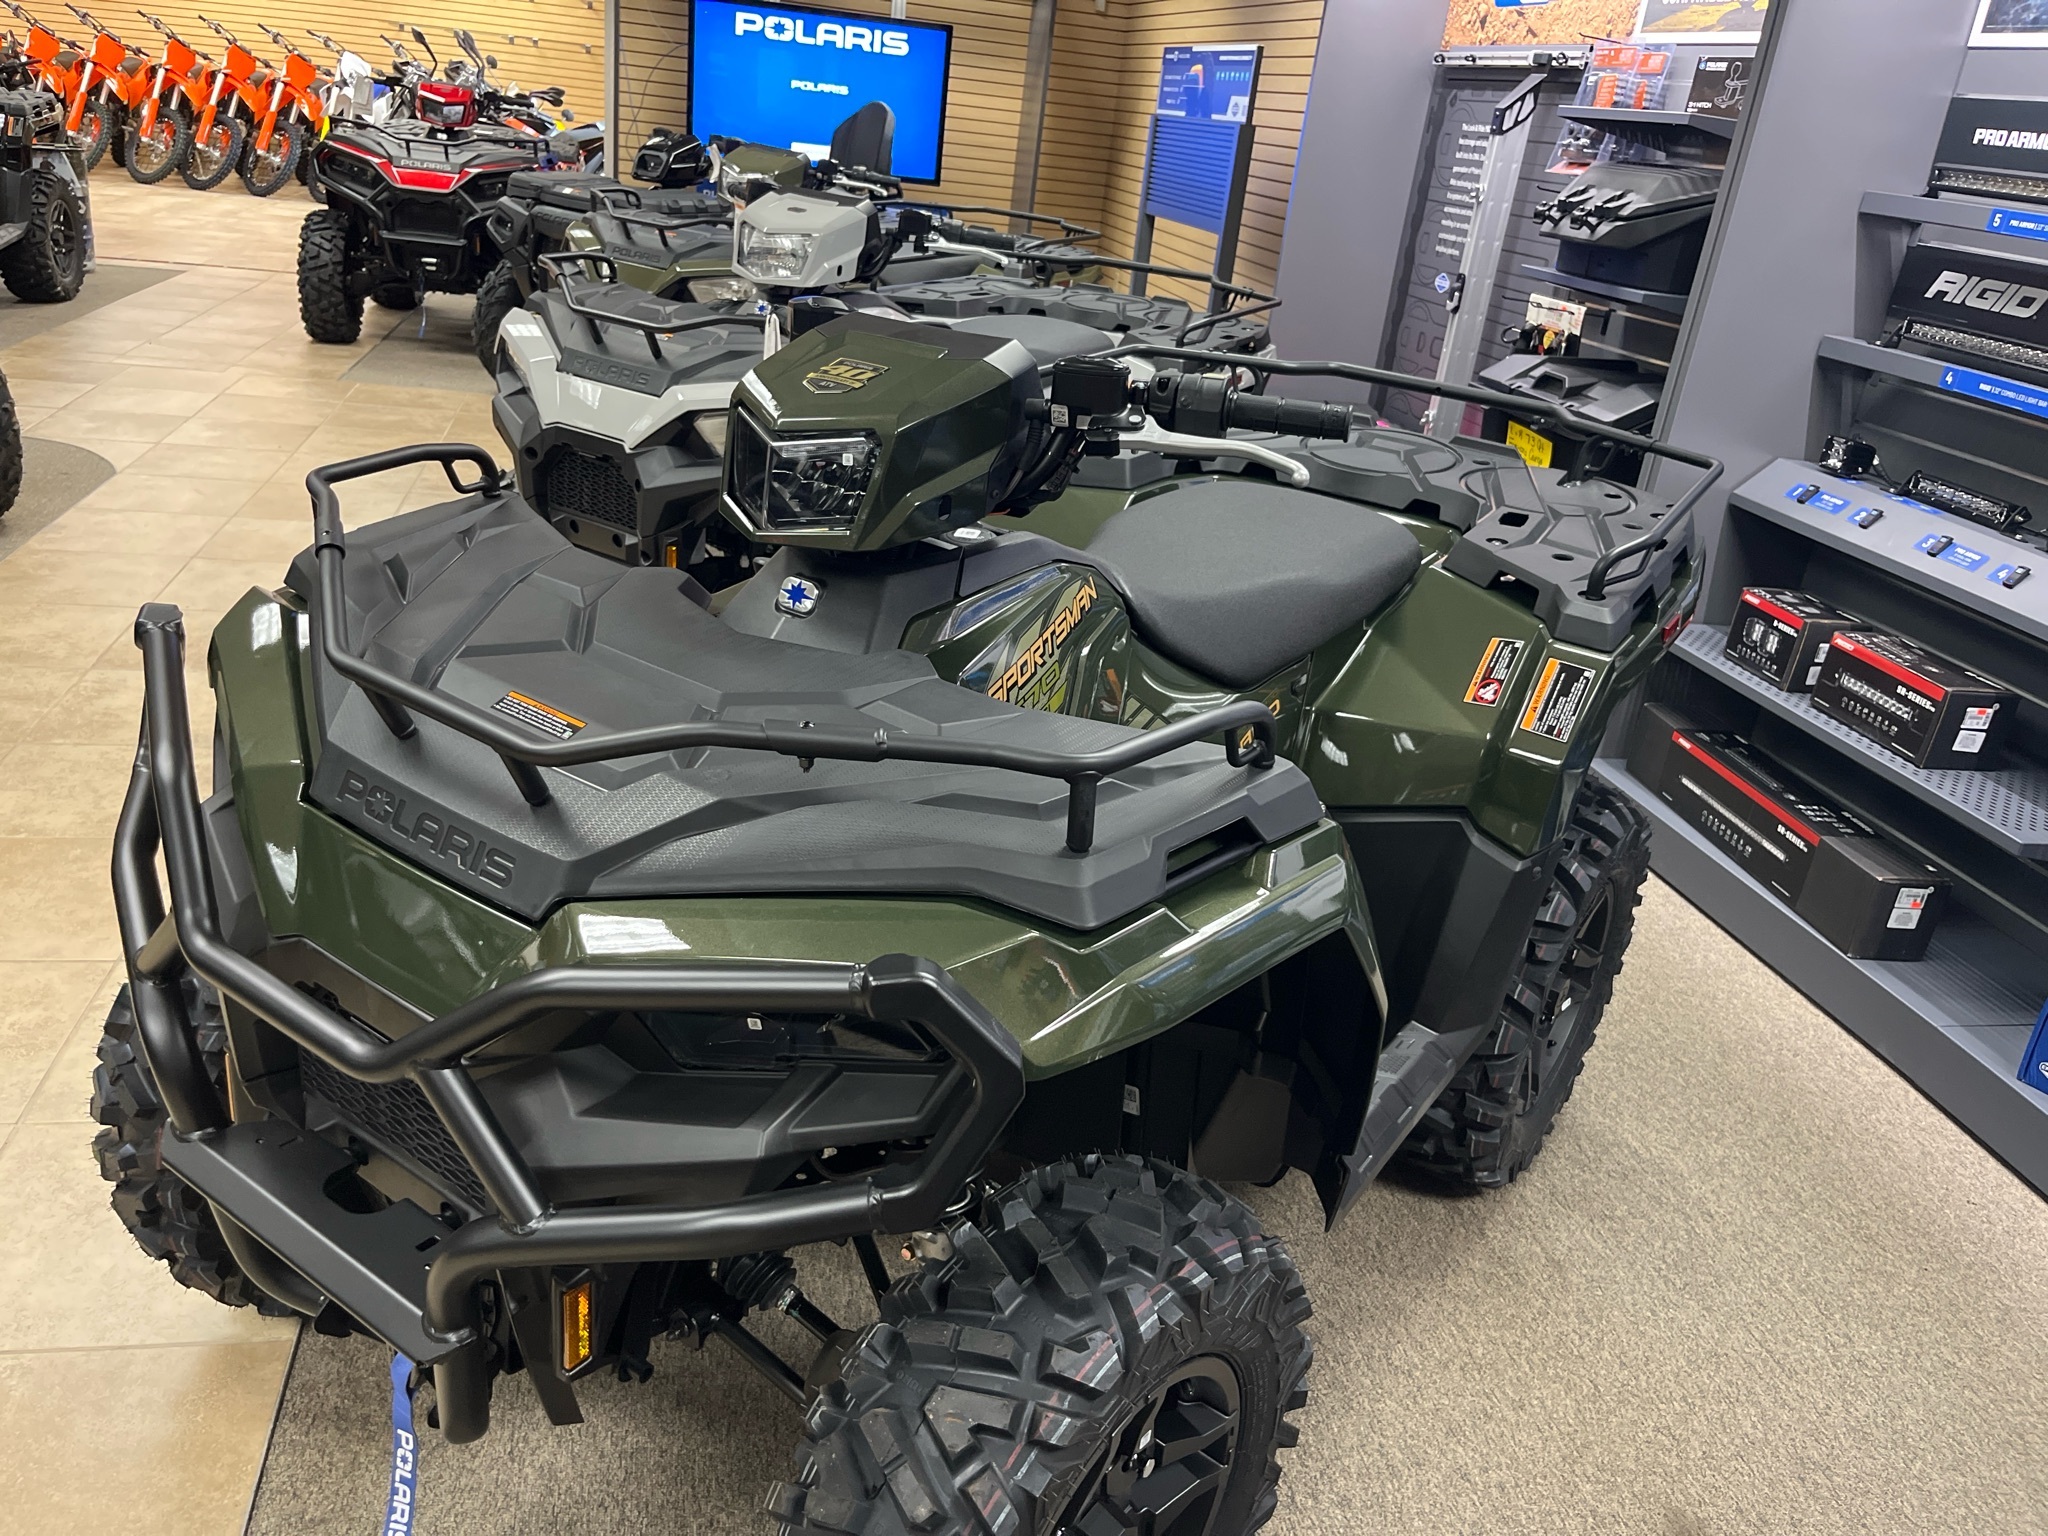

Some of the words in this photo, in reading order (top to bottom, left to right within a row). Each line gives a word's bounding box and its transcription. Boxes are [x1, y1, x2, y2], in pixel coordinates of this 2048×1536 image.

[735, 11, 910, 56] POLARIS
[790, 79, 849, 96] POLARIS
[400, 159, 452, 171] POLARIS
[1992, 213, 2003, 227] 5
[612, 246, 662, 263] POLARIS
[1924, 270, 2048, 319] RIGID
[572, 355, 651, 388] POLARIS
[820, 364, 878, 380] 40
[1945, 371, 1953, 385] 4
[818, 380, 838, 389] ATV
[2001, 387, 2016, 399] COMBO
[2016, 390, 2026, 401] LED
[2025, 393, 2038, 405] LIGHT
[2037, 397, 2048, 408] BAR
[1792, 487, 1803, 496] 1
[1853, 511, 1867, 521] 2
[1921, 537, 1935, 548] 3
[1997, 568, 2009, 580] 4
[987, 575, 1098, 702] SPORTSMAN
[1475, 653, 1491, 682] WARNING
[1532, 675, 1550, 706] WARNING
[1896, 684, 1931, 709] SR-SERIES
[335, 769, 517, 889] POLARIS
